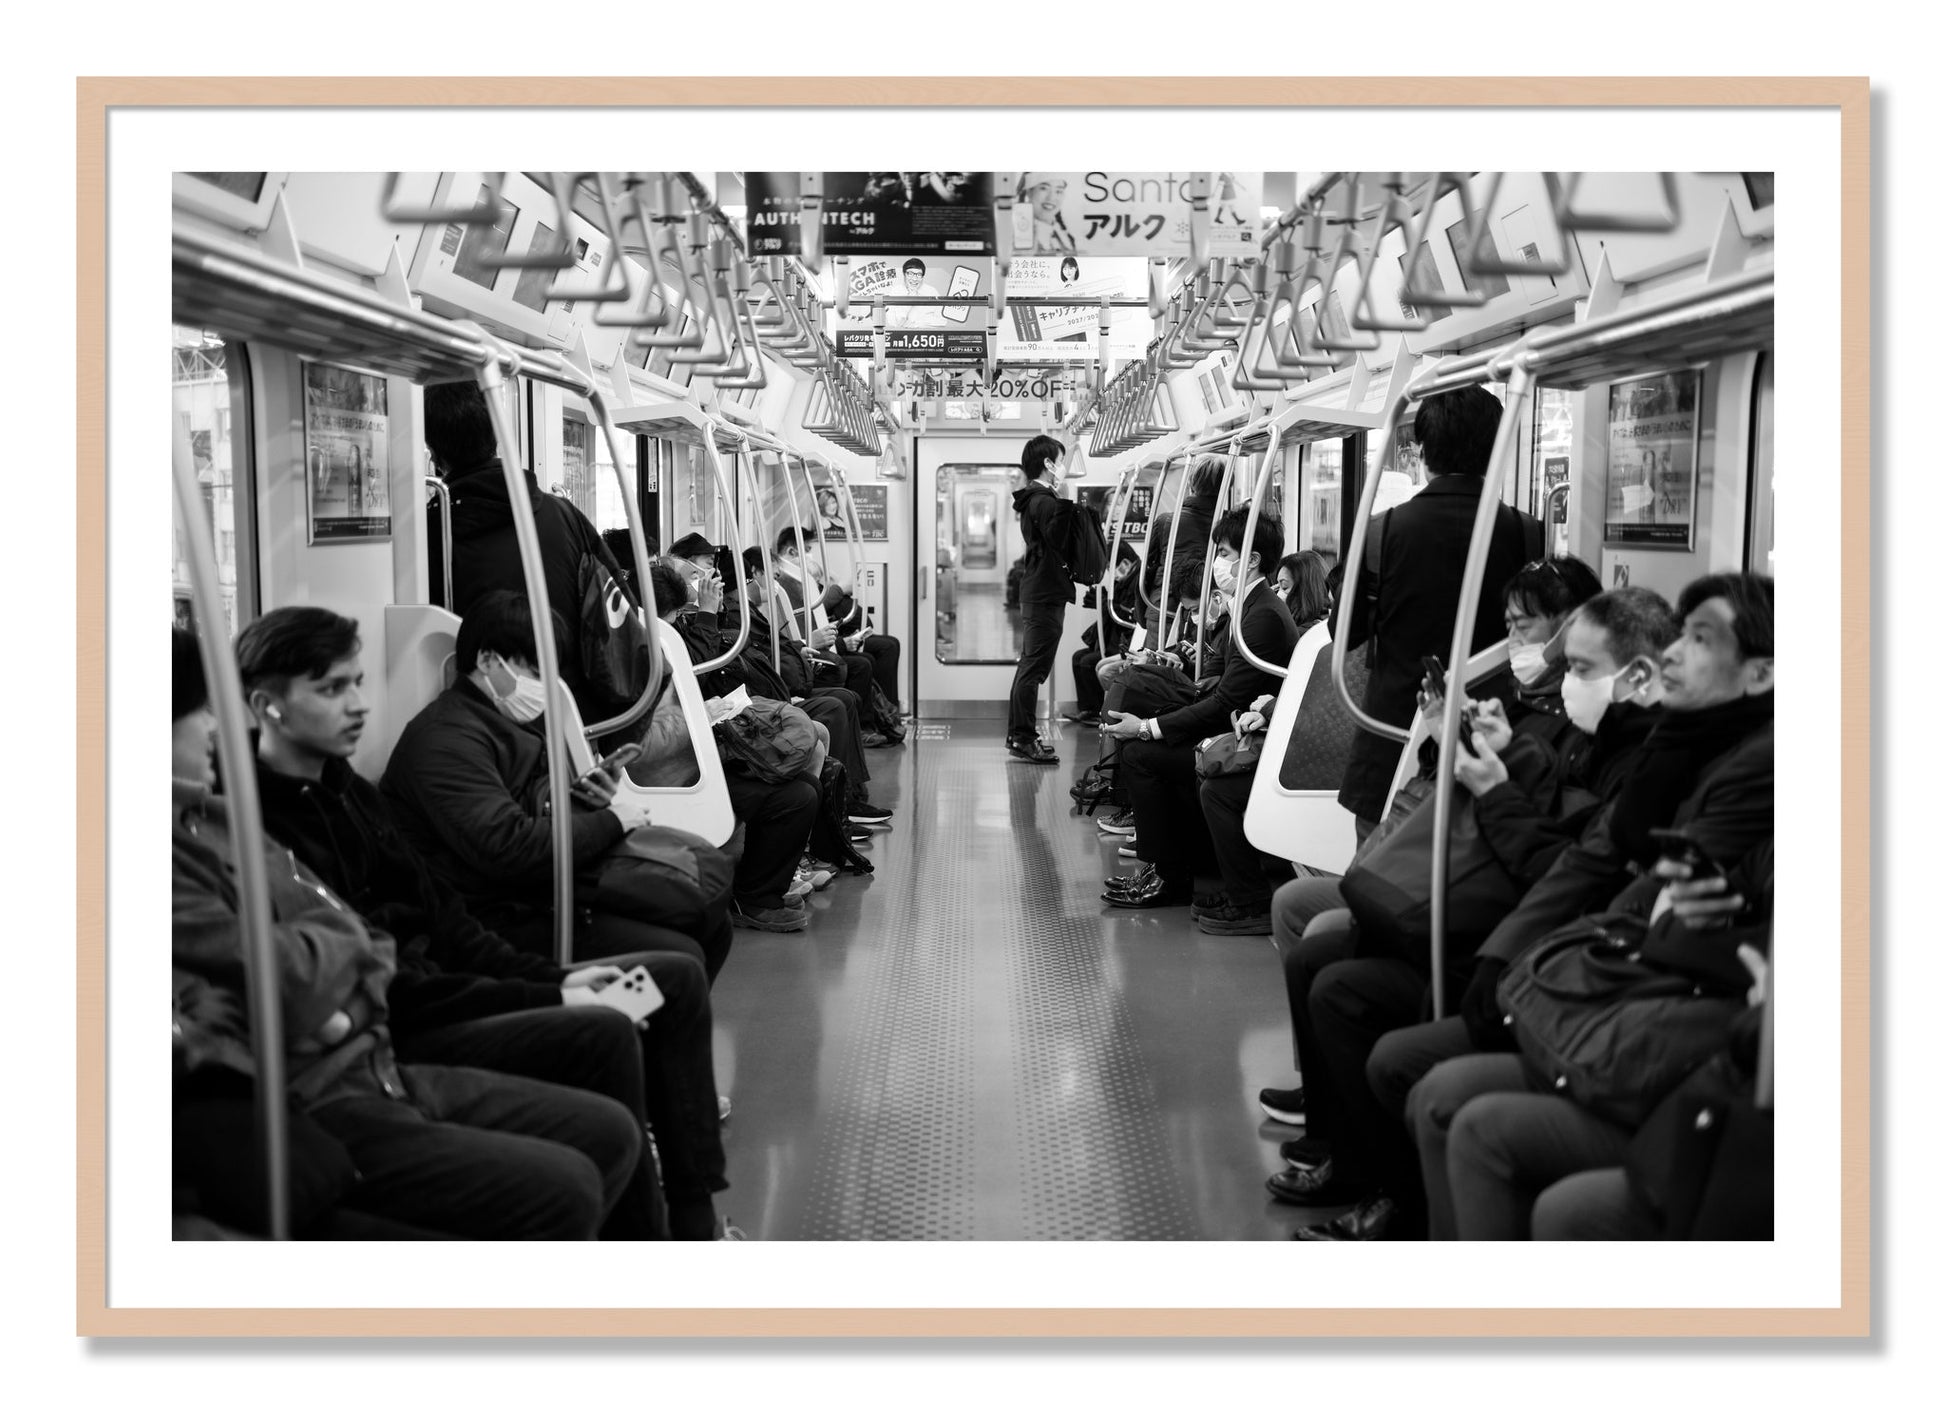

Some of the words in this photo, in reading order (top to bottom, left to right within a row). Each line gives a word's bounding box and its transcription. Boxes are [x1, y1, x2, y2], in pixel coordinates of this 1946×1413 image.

[1082, 214, 1167, 241] アルク
[849, 261, 888, 282] スマホで
